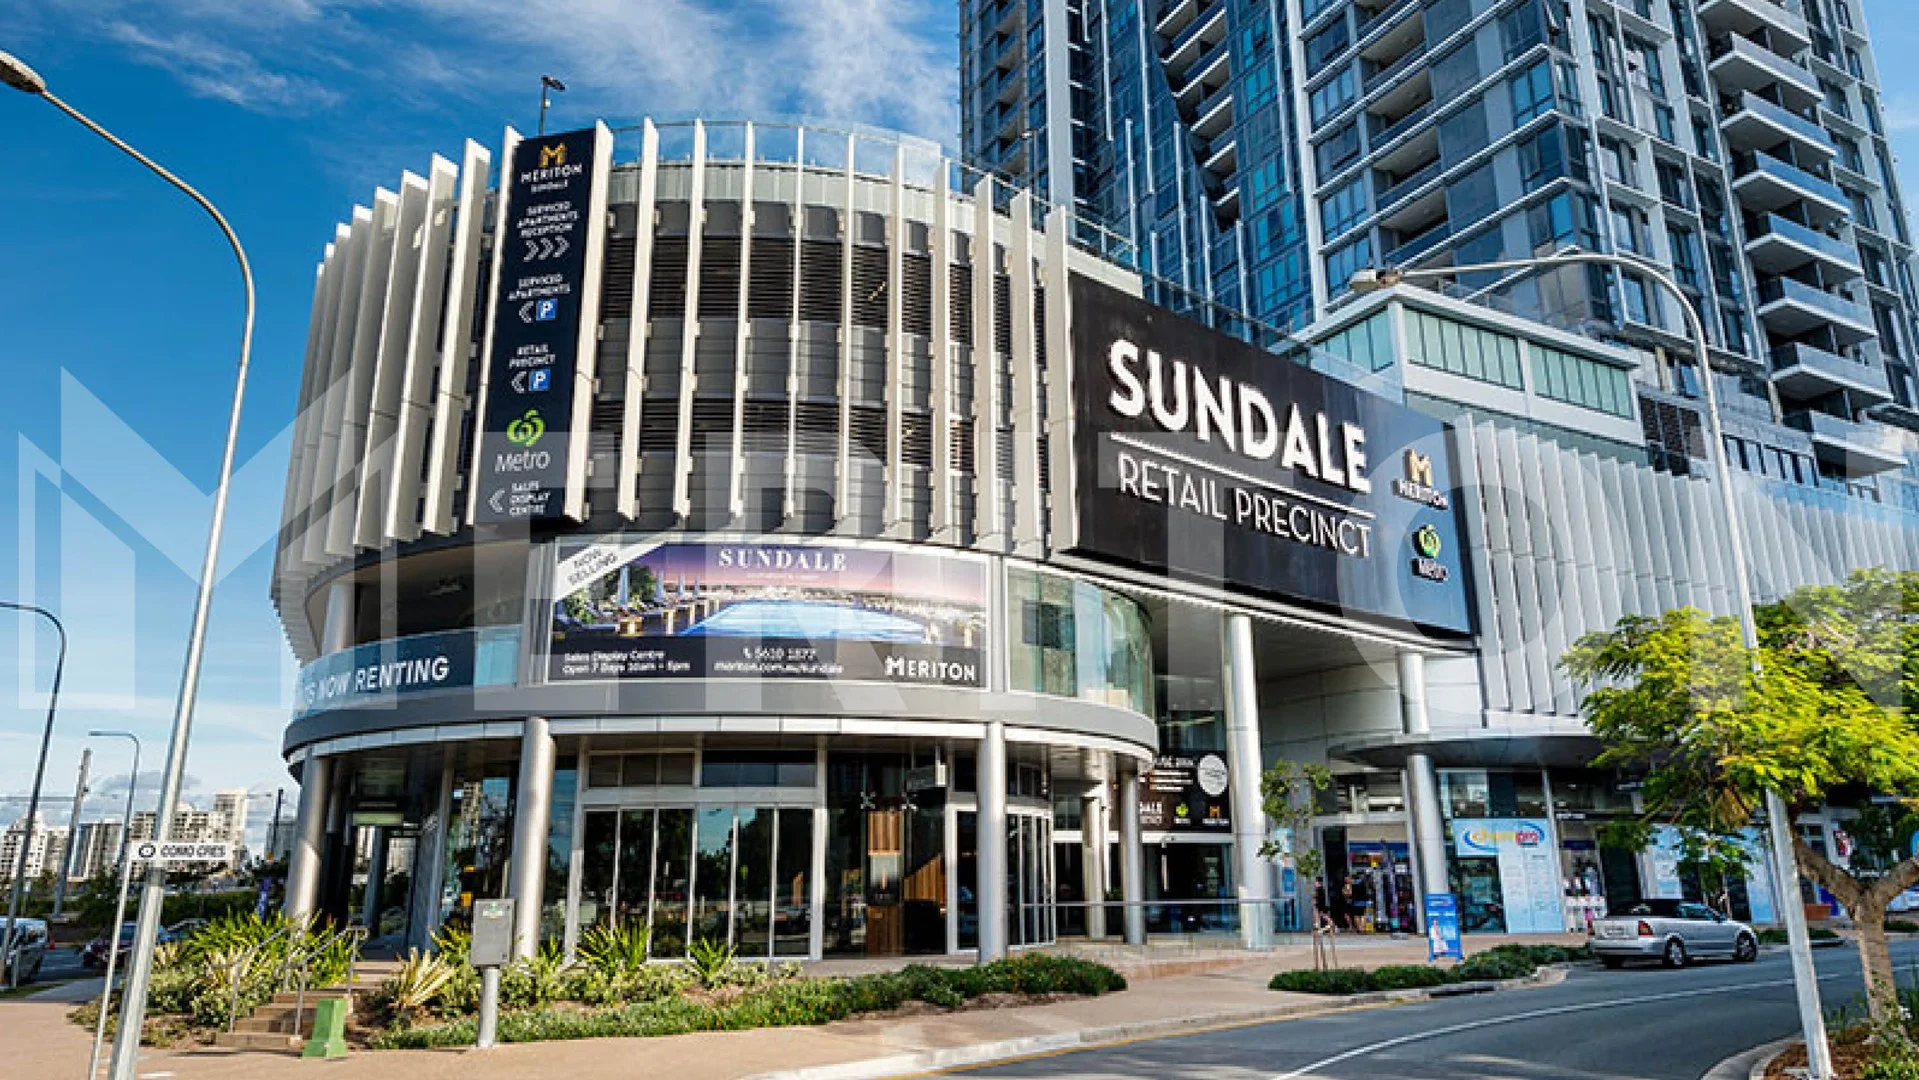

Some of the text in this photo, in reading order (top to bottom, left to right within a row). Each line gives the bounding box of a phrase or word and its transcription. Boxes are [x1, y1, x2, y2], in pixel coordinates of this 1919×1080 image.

[521, 163, 582, 184] MERITON
[526, 201, 570, 215] SERVICED
[517, 210, 578, 229] APARTMENTS
[521, 222, 573, 238] RECEPTION
[518, 274, 563, 289] SERVICED
[508, 282, 570, 301] APARTMENTS
[540, 300, 554, 319] P
[517, 342, 549, 356] RETAIL
[508, 354, 556, 369] PRECINCT
[533, 370, 547, 390] P
[1109, 339, 1370, 493] SUNDALE
[495, 451, 550, 472] Metro
[510, 491, 551, 504] DISPLAY
[1397, 479, 1448, 509] MERITON
[509, 503, 546, 517] CENTRE
[1118, 453, 1372, 559] RETAIL PRECINCT
[573, 548, 602, 570] NOW
[719, 548, 846, 571] SUNDALE
[566, 552, 618, 586] SELLING
[592, 650, 628, 664] Display
[629, 650, 665, 660] Centre
[884, 655, 976, 682] MERITON
[318, 671, 352, 701] NOW
[355, 656, 448, 691] RENTING
[160, 844, 227, 859] COMO CRES
